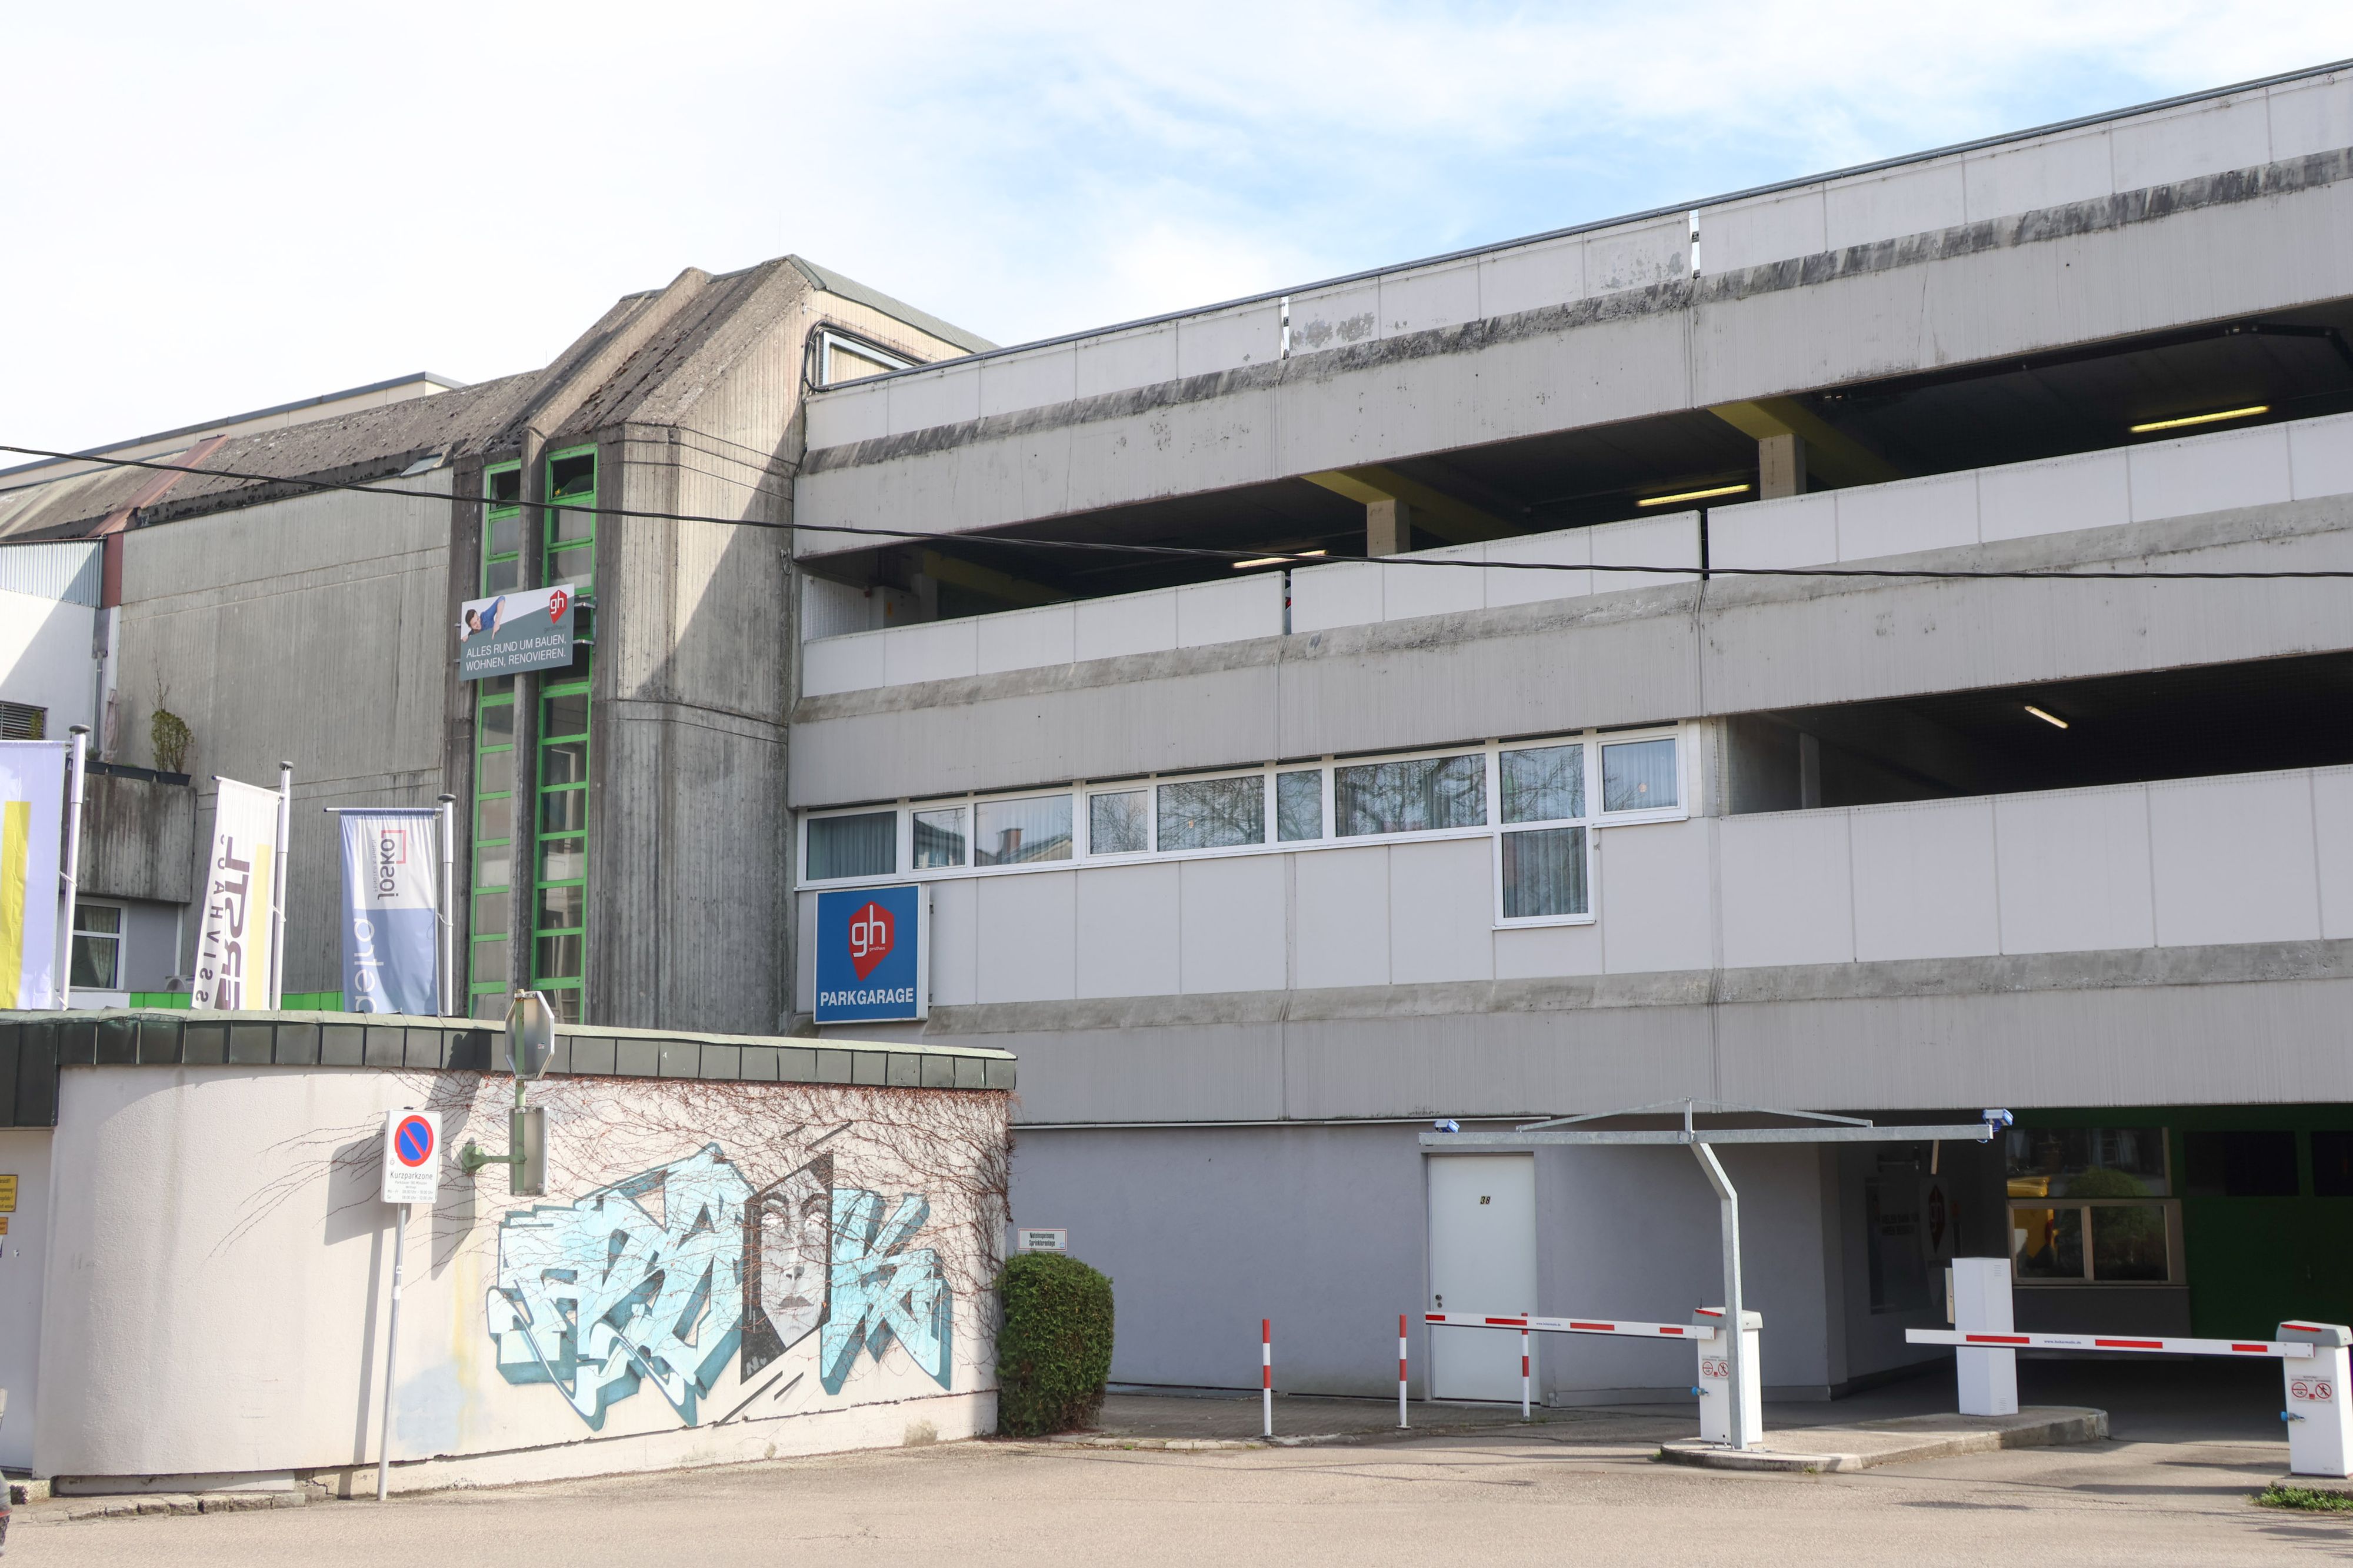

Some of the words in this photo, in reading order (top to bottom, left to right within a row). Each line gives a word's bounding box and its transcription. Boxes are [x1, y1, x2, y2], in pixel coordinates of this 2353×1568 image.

[549, 590, 564, 614] gh
[466, 645, 491, 658] ALLES
[494, 641, 518, 654] RUND
[519, 639, 533, 650] UM
[535, 634, 566, 648] BAUEN,
[466, 656, 506, 672] WOHNEN,
[508, 648, 566, 665] RENOVIEREN.
[851, 905, 885, 958] gh
[820, 987, 914, 1006] PARKGARAGE
[390, 1171, 433, 1180] Kurzparkzone
[1480, 1196, 1491, 1205] 38
